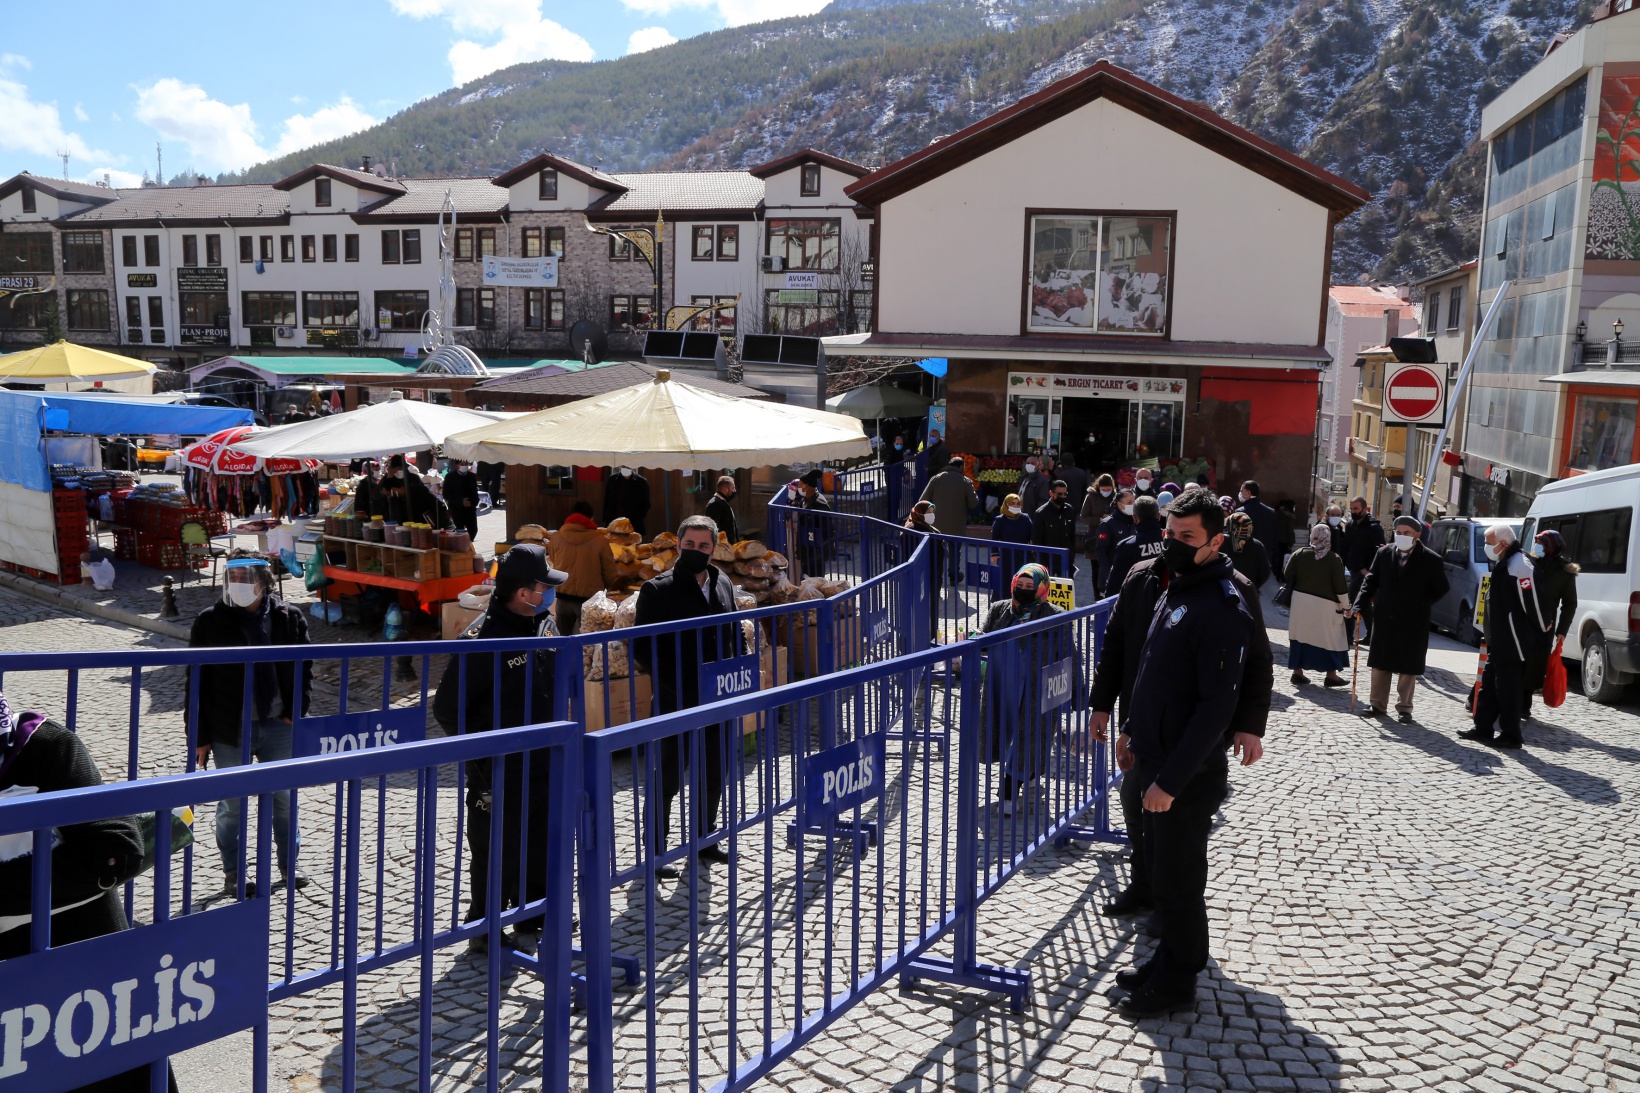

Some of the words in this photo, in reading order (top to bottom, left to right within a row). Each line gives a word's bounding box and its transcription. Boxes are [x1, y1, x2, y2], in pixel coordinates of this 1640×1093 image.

[0, 278, 22, 287] FRASI
[24, 278, 33, 287] 29
[1067, 378, 1091, 388] ERGİN
[1092, 378, 1124, 390] TİCARET
[980, 571, 989, 583] 29
[717, 666, 752, 696] POLİS
[1047, 670, 1068, 699] POLİS
[822, 752, 873, 804] POLİS
[0, 954, 215, 1080] POLİS
